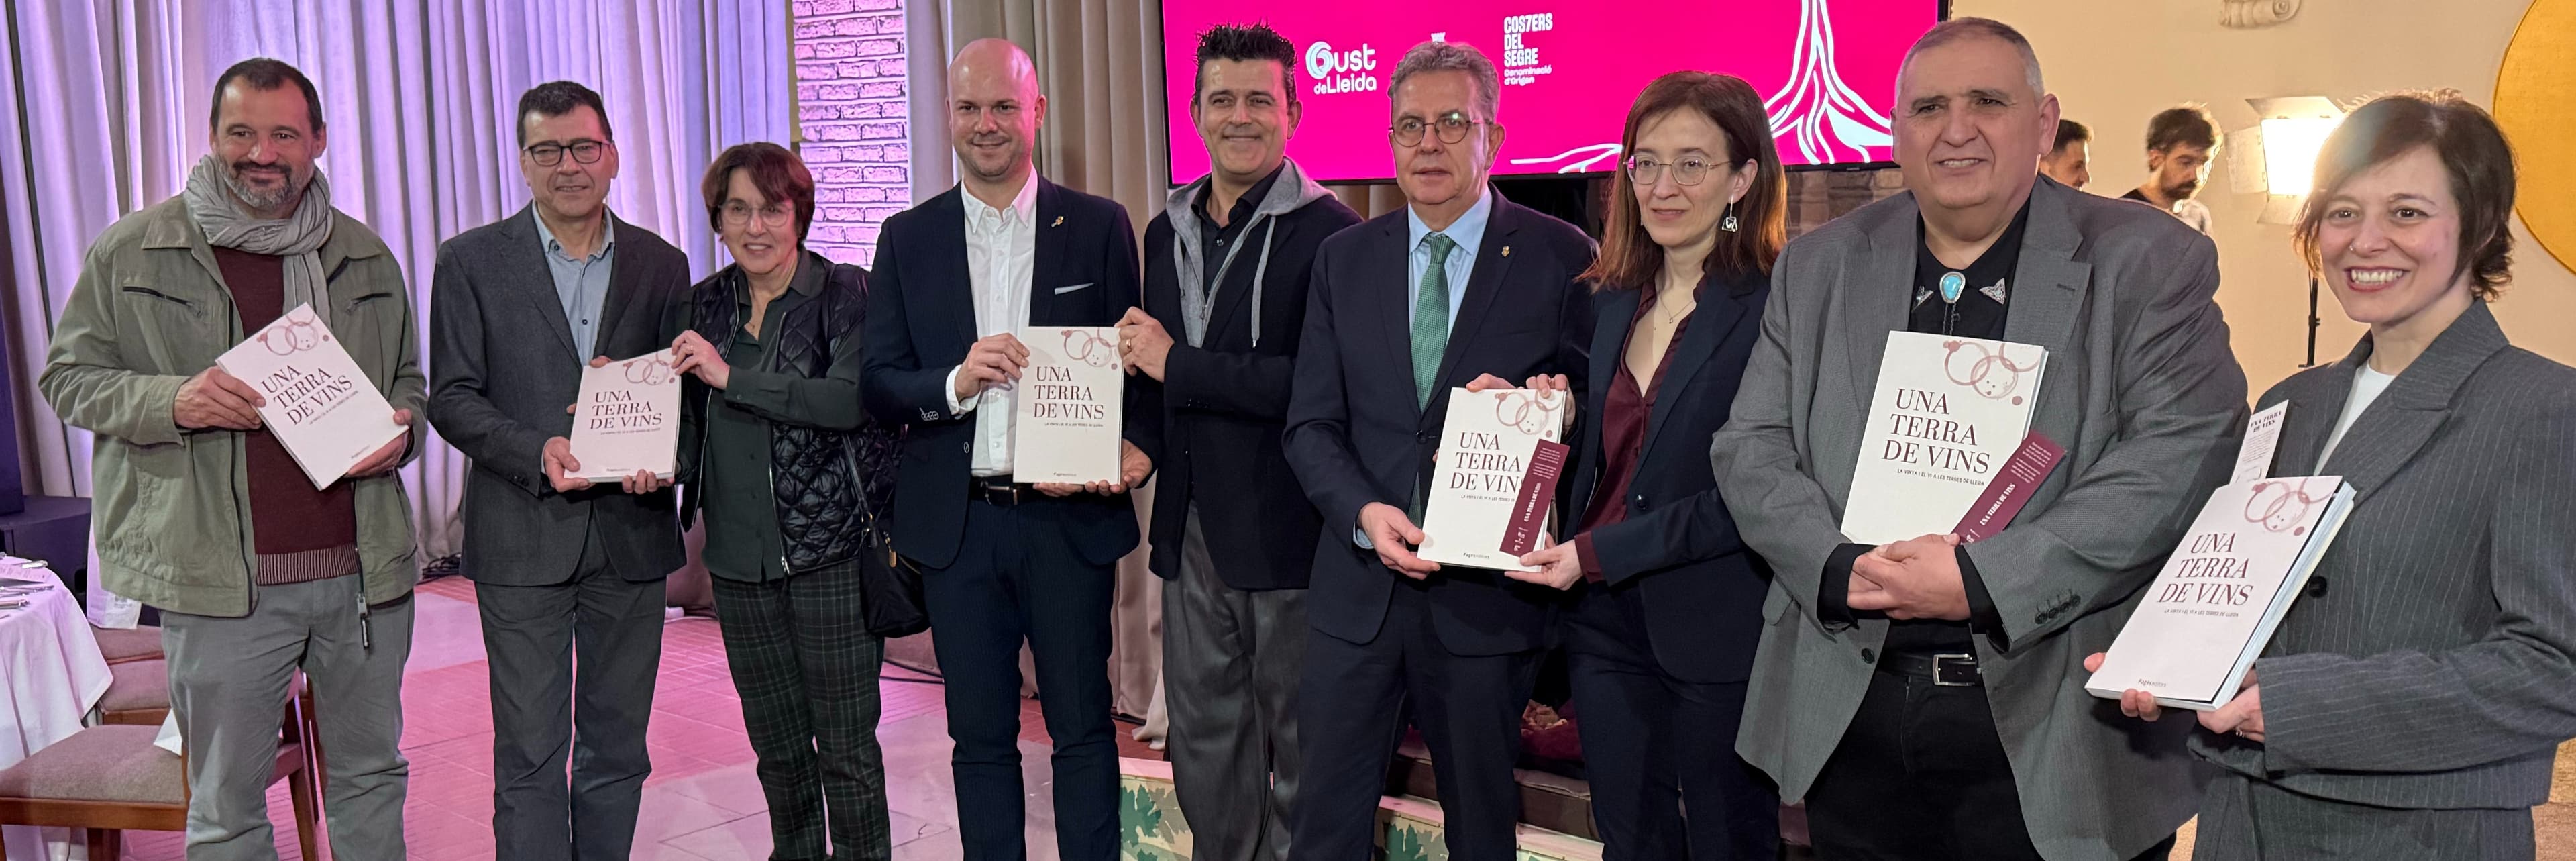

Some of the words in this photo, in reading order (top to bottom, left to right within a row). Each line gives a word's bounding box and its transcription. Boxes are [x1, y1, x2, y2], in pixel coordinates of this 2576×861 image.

[1504, 33, 1524, 50] DEL
[1305, 41, 1377, 79] Gust
[1504, 48, 1538, 67] SEGRE
[261, 365, 301, 393] UNA
[1036, 366, 1072, 381] UNA
[273, 368, 333, 409] TERRA
[595, 391, 631, 402] UNA
[1034, 385, 1093, 401] TERRA
[285, 402, 314, 425] DE
[312, 375, 352, 408] VINS
[592, 401, 652, 416] TERRA
[1896, 388, 1949, 415] UNA
[590, 417, 614, 429] DE
[621, 413, 662, 427] VINS
[1033, 403, 1057, 418] DE
[1063, 404, 1104, 419] VINS
[1890, 413, 1978, 446] TERRA
[1460, 432, 1500, 450] UNA
[1456, 452, 1521, 471] TERRA
[1882, 440, 1919, 464] DE
[1927, 444, 1990, 474] VINS
[1450, 472, 1477, 490] DE
[1485, 474, 1523, 493] VIN
[2190, 532, 2236, 554] UNA
[2175, 558, 2249, 579] TERRA
[2157, 583, 2193, 603] DE
[2196, 583, 2253, 605] VINS
